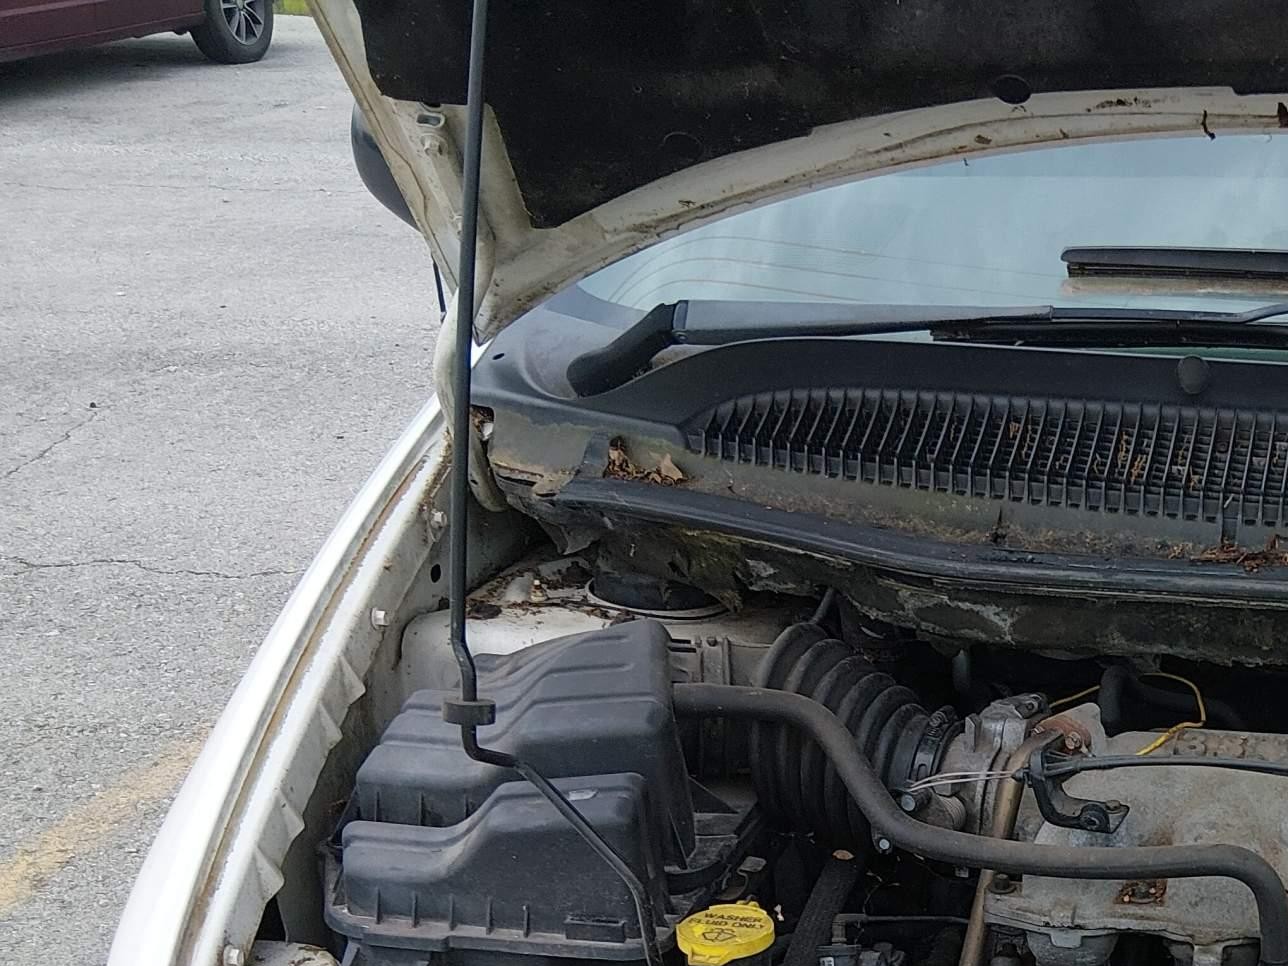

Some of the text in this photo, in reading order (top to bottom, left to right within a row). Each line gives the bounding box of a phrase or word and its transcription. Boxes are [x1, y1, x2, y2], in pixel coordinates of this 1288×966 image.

[688, 917, 766, 930] FLUID ONLY
[704, 912, 763, 923] WASHER
